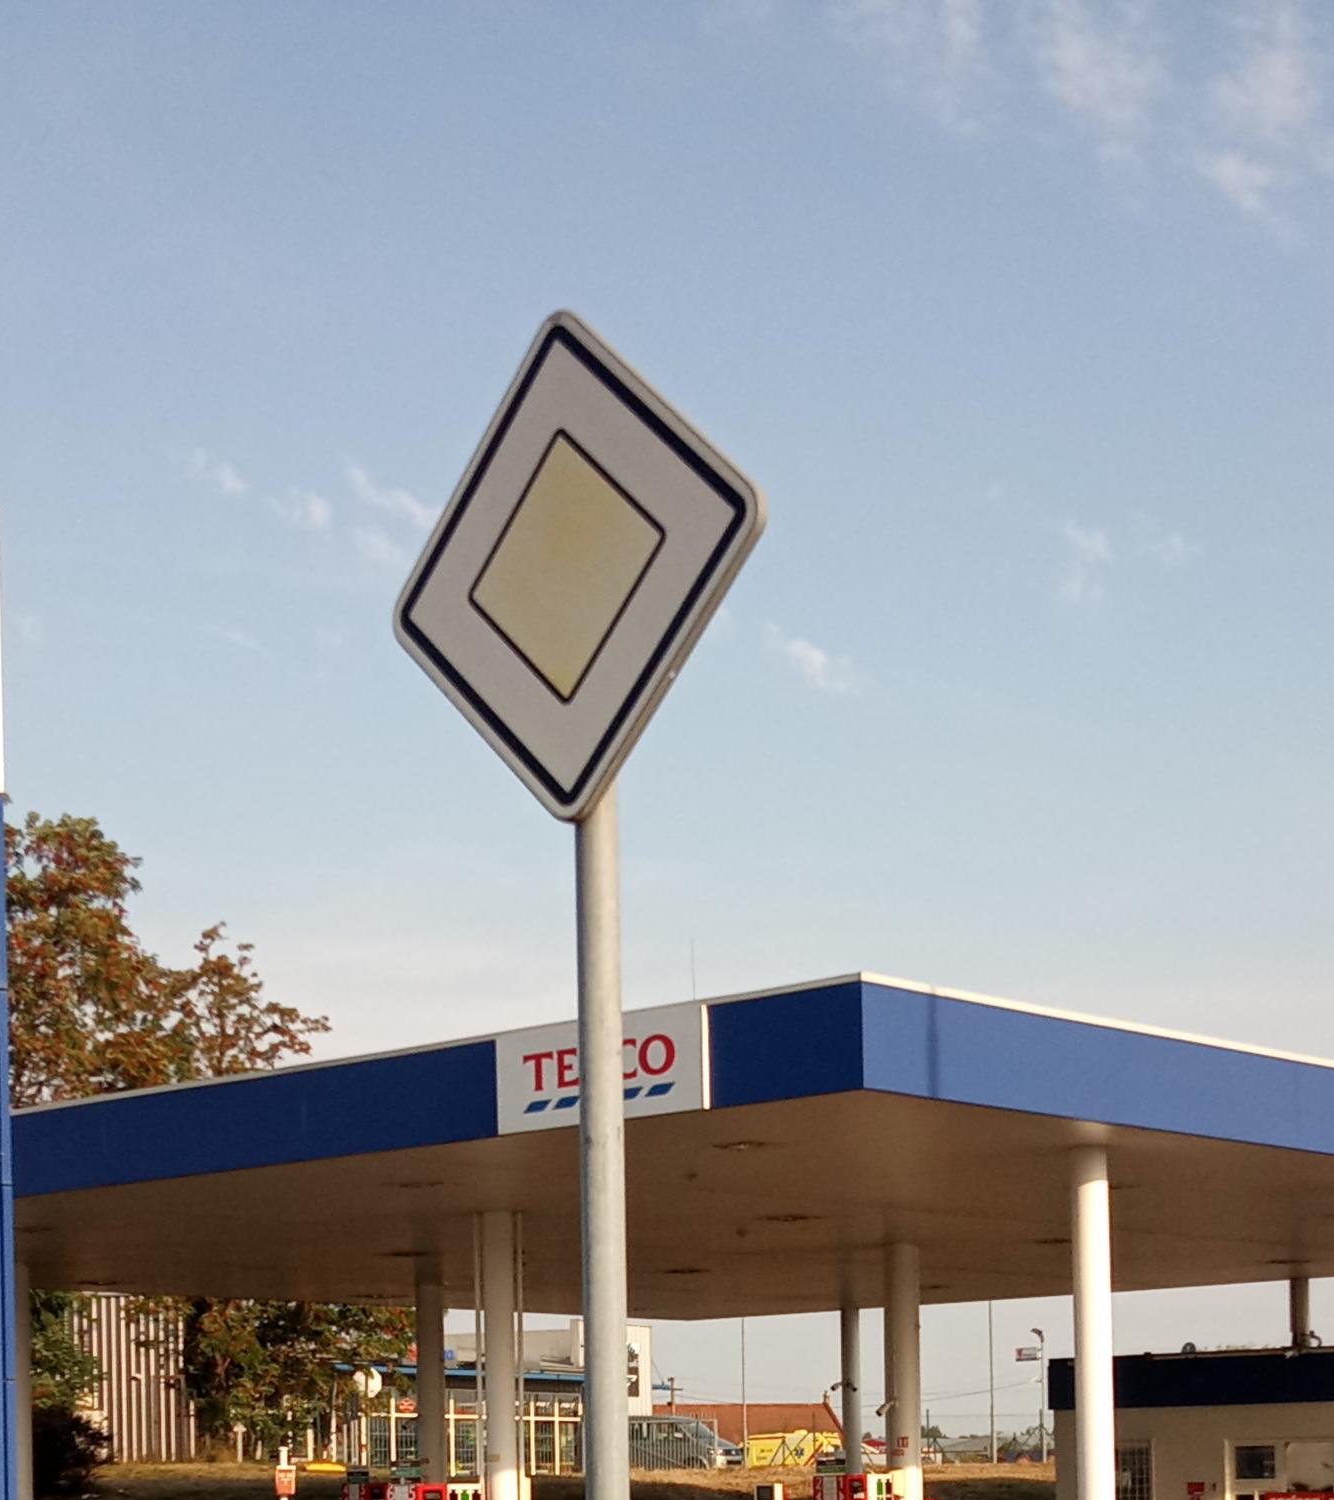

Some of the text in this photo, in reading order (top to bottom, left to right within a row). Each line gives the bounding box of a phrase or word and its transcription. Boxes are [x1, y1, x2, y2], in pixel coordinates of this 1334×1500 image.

[522, 1033, 676, 1092] TECO
[387, 1484, 394, 1500] 6
[409, 1484, 416, 1500] 5
